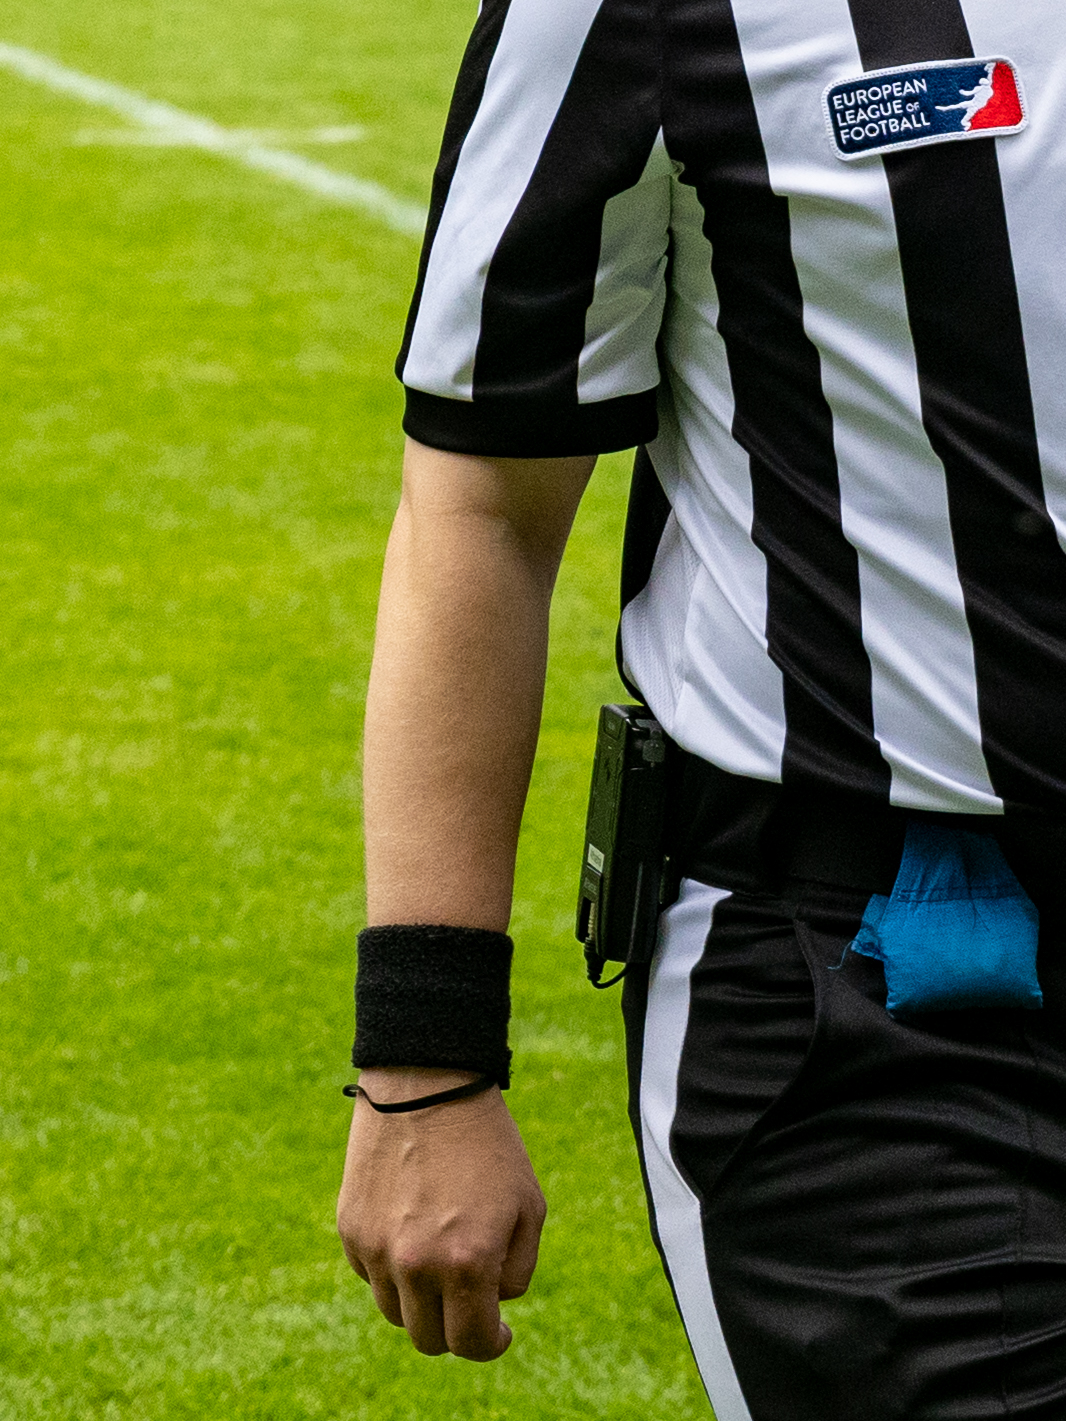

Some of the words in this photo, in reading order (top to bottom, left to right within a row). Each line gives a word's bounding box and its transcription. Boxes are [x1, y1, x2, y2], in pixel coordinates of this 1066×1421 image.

[833, 78, 928, 110] EUROPEAN
[836, 99, 904, 127] LEAGUE
[905, 101, 920, 113] OF
[840, 111, 931, 145] FOOTBALL
